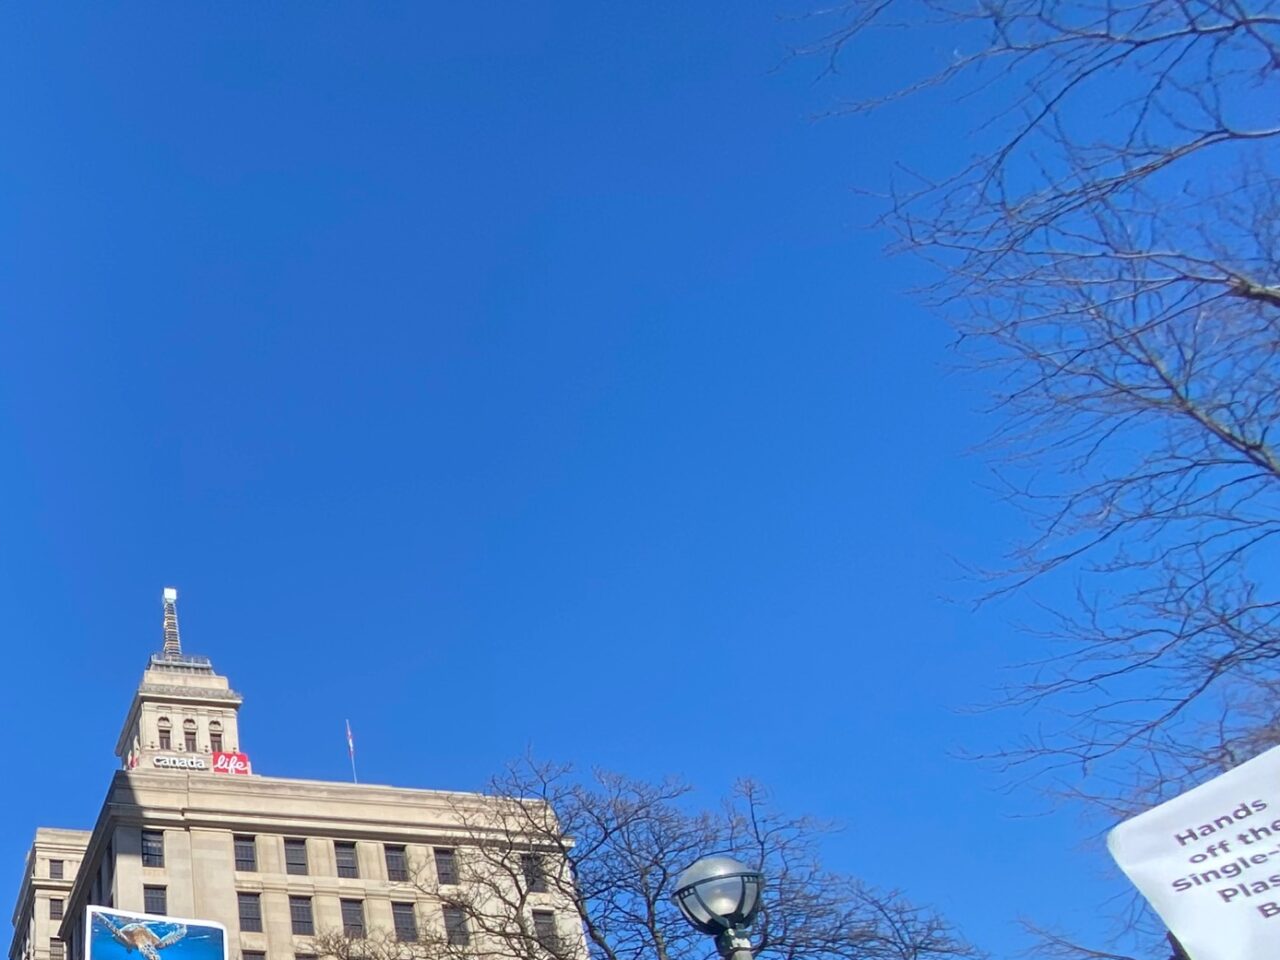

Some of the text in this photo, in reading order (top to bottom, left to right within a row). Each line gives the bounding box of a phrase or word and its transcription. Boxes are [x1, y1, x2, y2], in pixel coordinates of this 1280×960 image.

[153, 754, 249, 774] canada life
[1174, 799, 1268, 846] Hands
[1189, 840, 1231, 864] off
[1171, 848, 1280, 892] Single-
